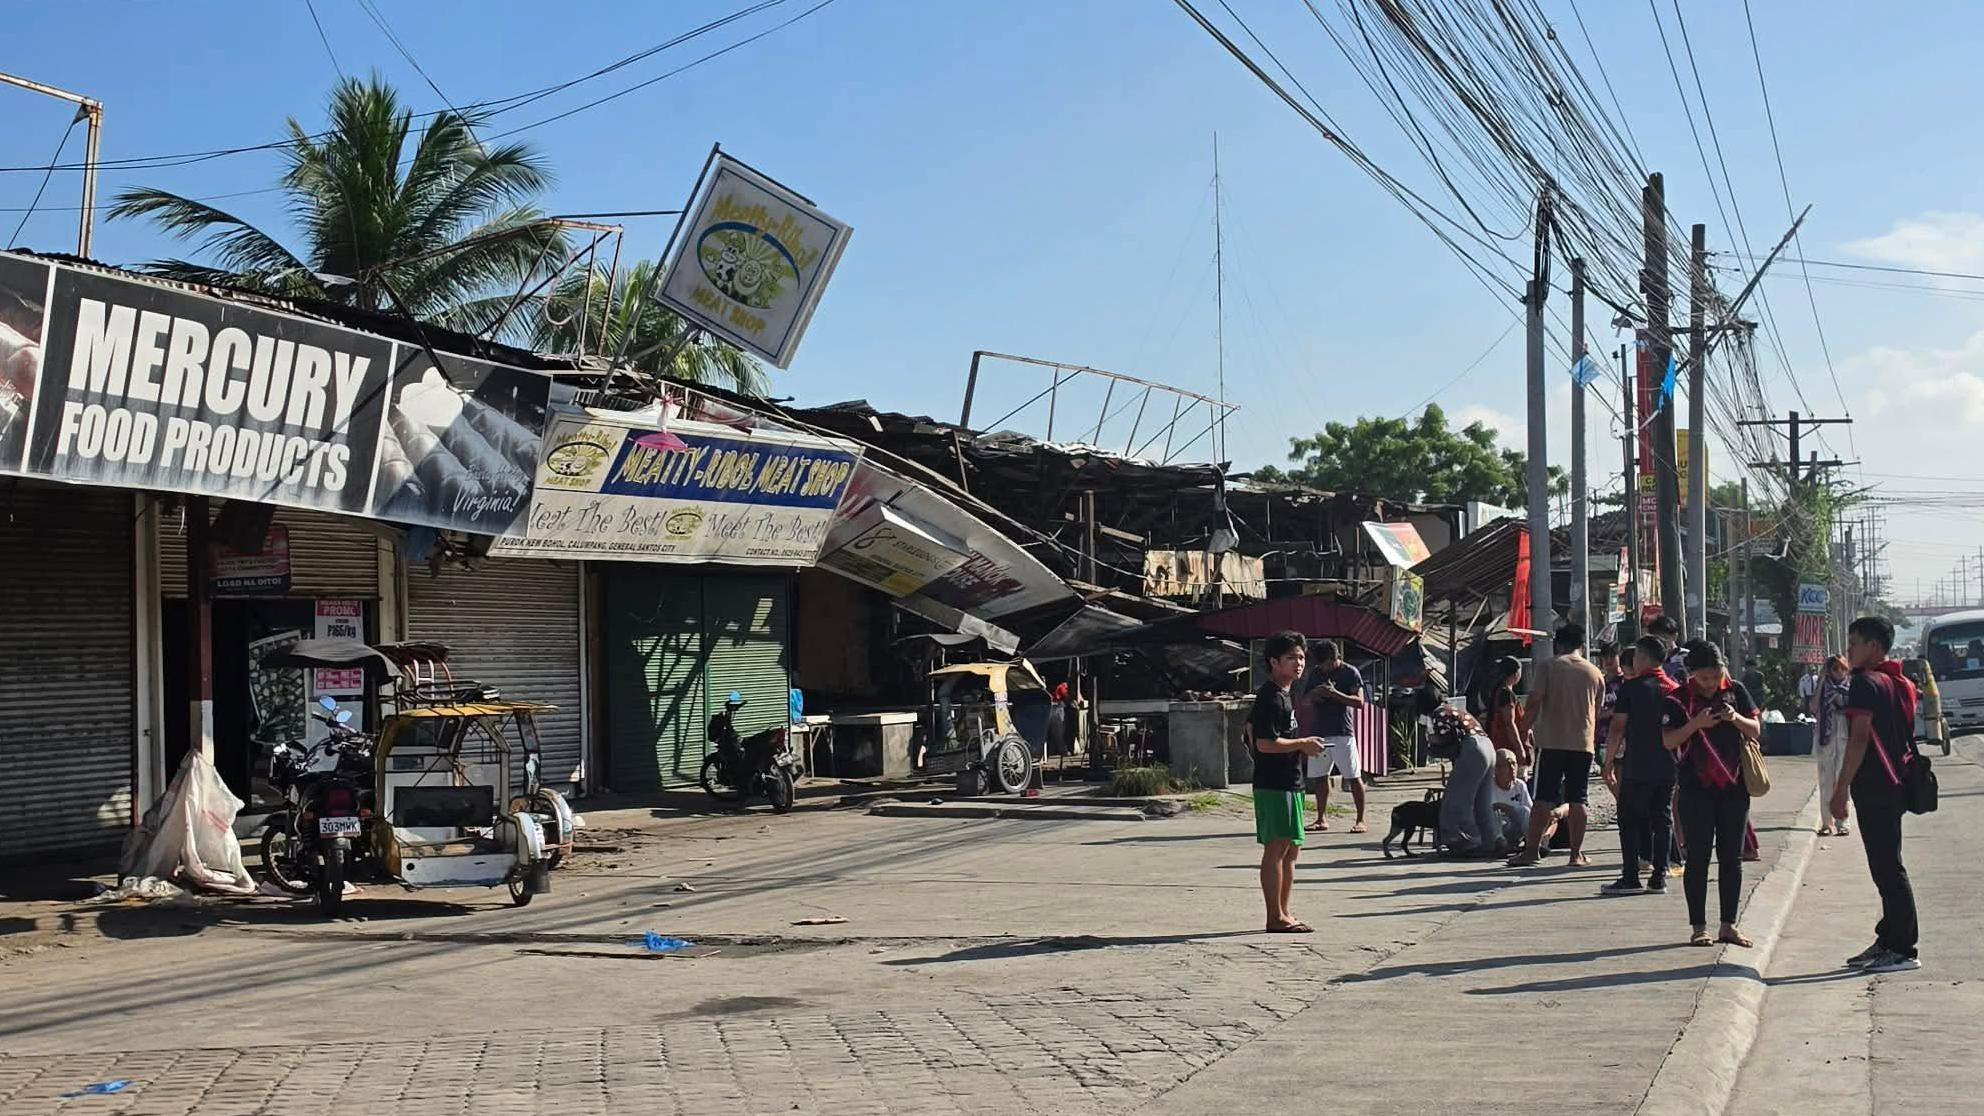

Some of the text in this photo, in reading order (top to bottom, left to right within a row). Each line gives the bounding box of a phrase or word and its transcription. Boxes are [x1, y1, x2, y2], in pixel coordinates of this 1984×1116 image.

[68, 298, 371, 434] MERCURY
[57, 401, 351, 491] FOOD PRODUCTS
[749, 454, 811, 496] MEAT
[801, 458, 850, 498] SHOP
[575, 499, 613, 533] The
[617, 504, 667, 537] Best!
[705, 512, 751, 540] Meet
[752, 511, 781, 543] The
[526, 538, 542, 548] NEW
[661, 544, 677, 554] CITY
[1800, 588, 1824, 604] KCC
